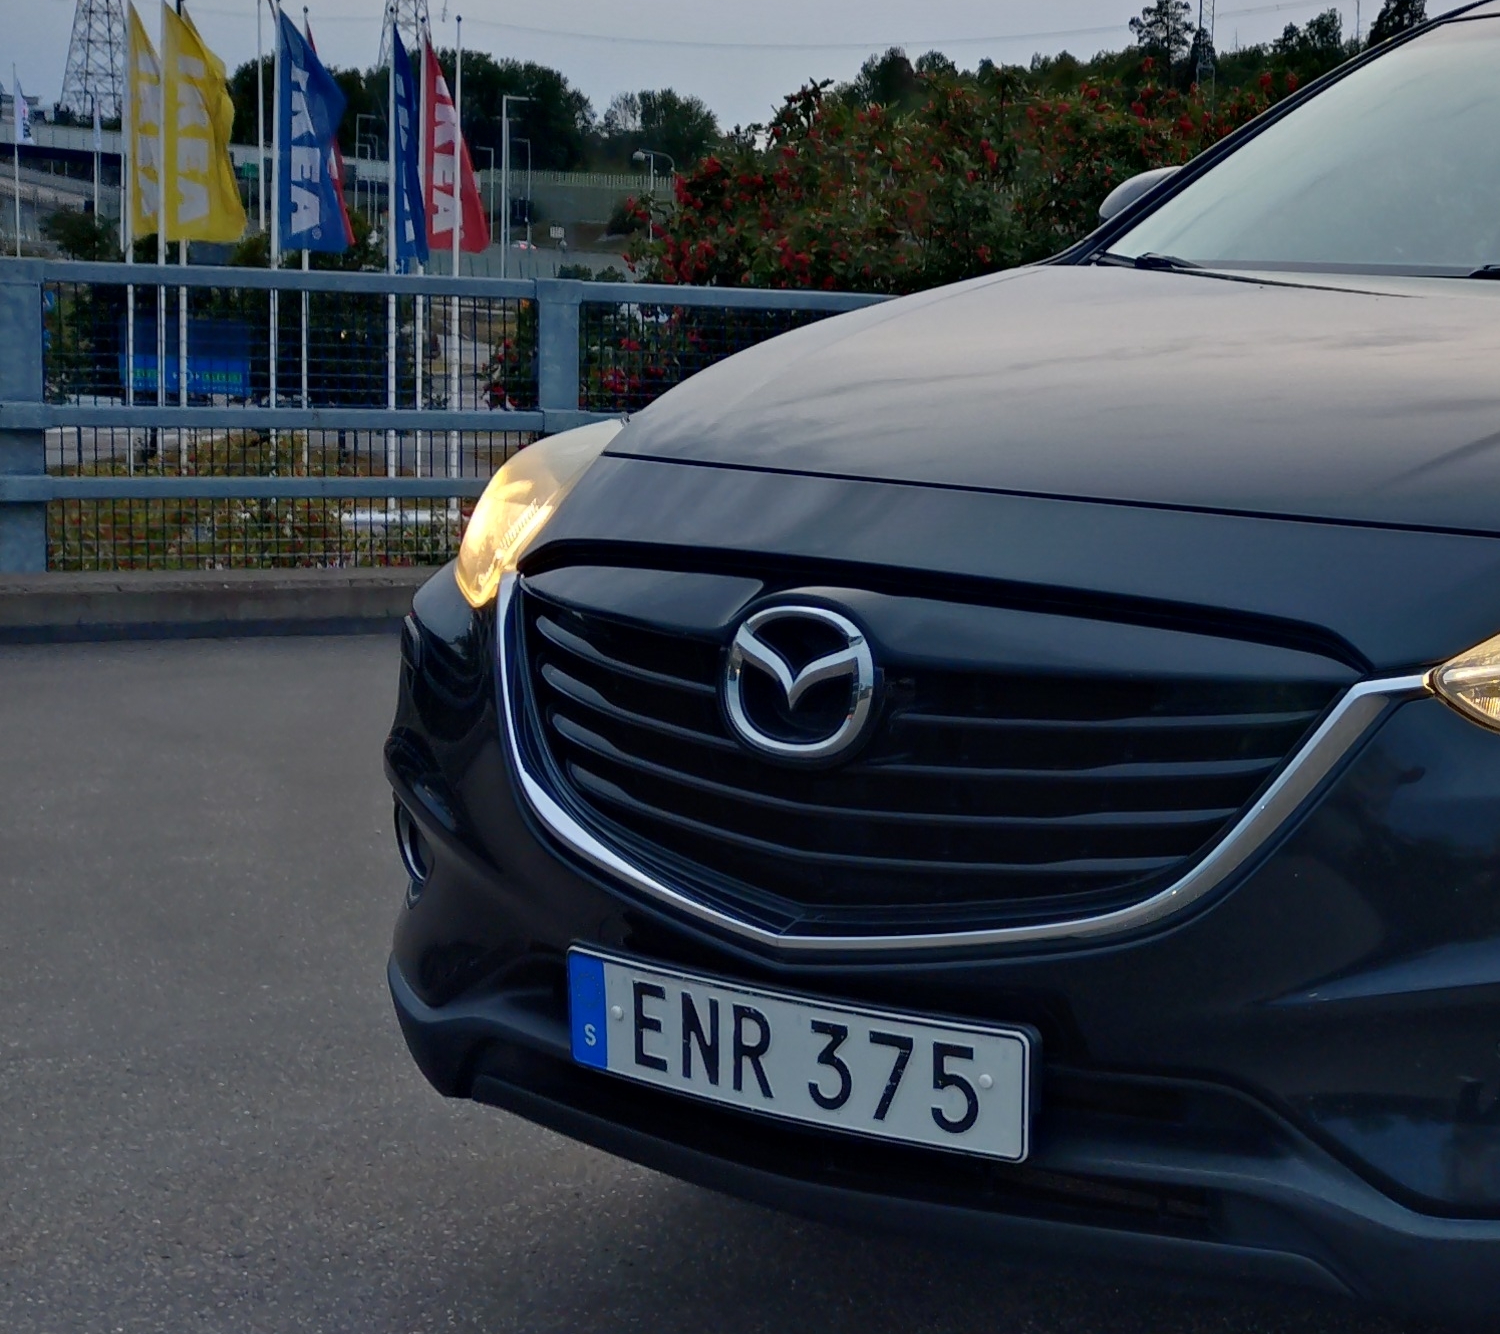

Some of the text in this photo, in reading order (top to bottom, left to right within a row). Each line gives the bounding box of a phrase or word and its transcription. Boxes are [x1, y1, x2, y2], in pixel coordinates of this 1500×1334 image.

[584, 1023, 597, 1047] S
[632, 979, 980, 1134] ENR 375
